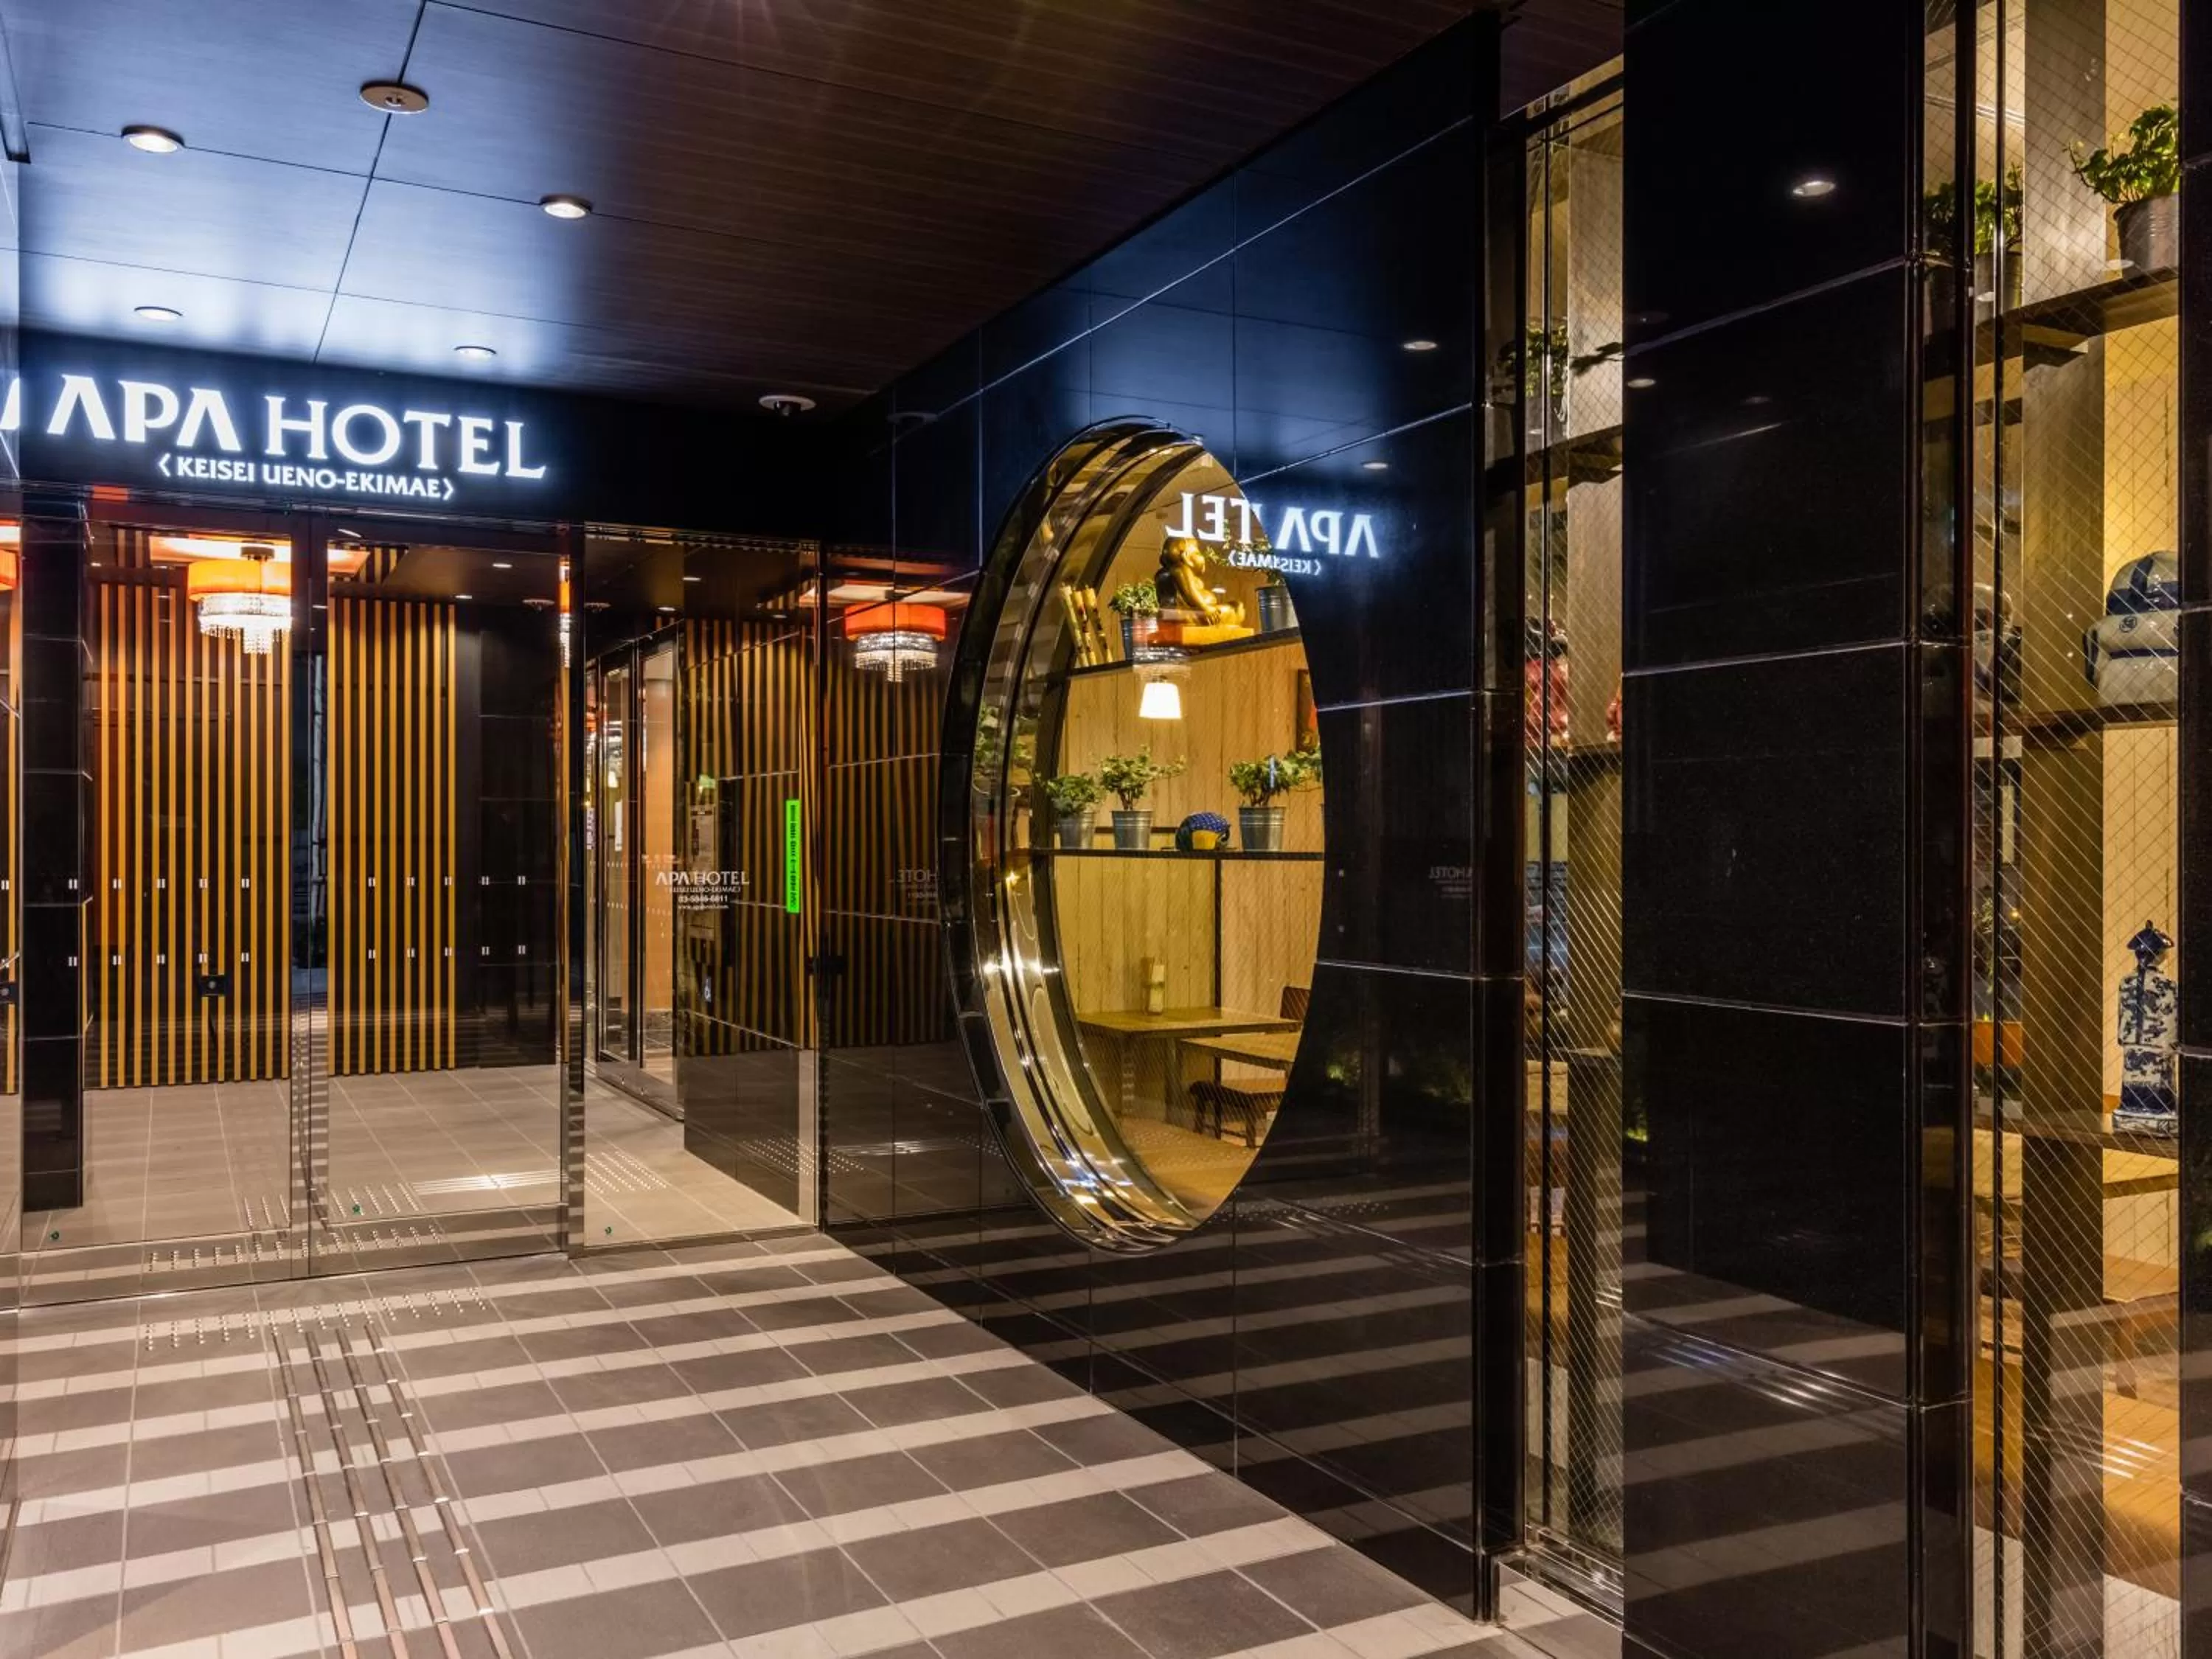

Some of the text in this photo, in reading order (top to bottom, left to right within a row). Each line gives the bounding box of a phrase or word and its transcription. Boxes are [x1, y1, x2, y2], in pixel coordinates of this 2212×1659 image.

[46, 373, 242, 452] APA
[264, 394, 547, 479] HOTEL
[655, 870, 750, 886] APA HOTEL
